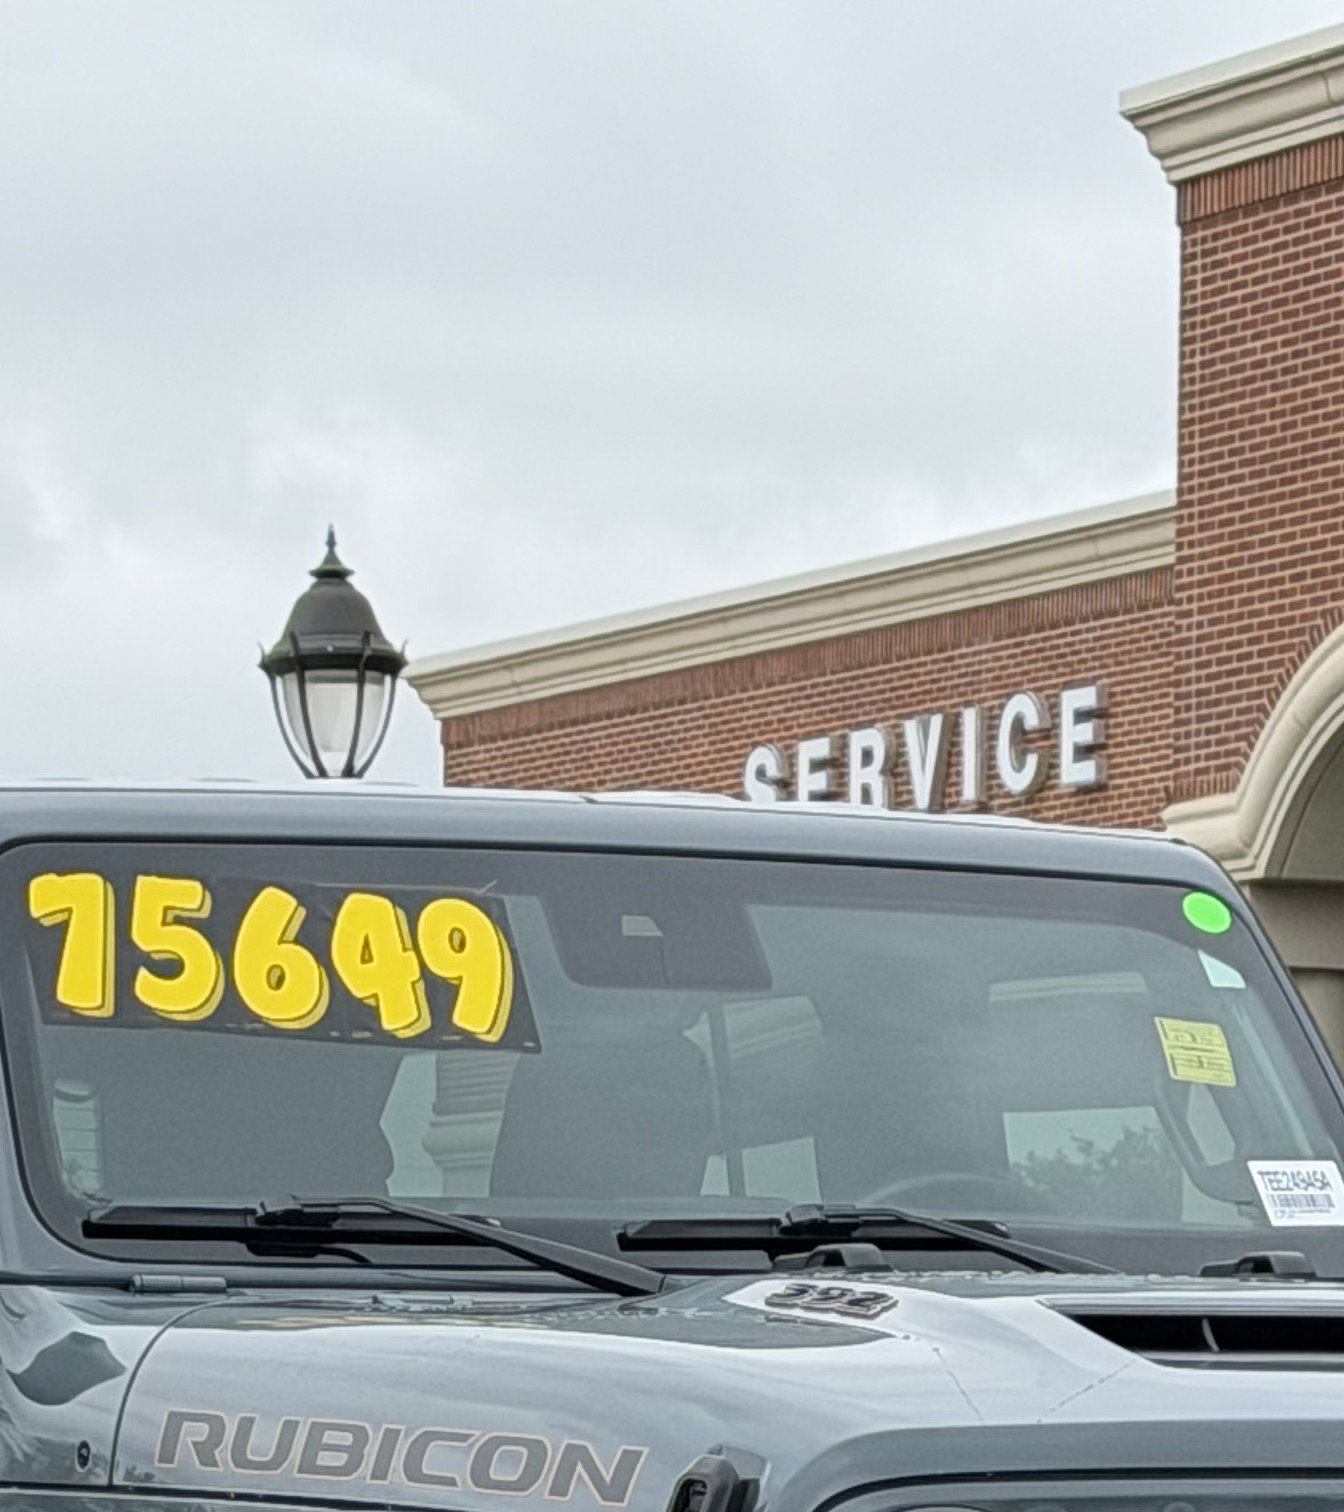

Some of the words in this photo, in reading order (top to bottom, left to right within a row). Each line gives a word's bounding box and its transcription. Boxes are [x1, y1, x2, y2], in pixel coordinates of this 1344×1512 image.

[743, 682, 1105, 811] SERVICE
[28, 871, 513, 1043] 75649
[154, 1408, 651, 1507] RUBICON
